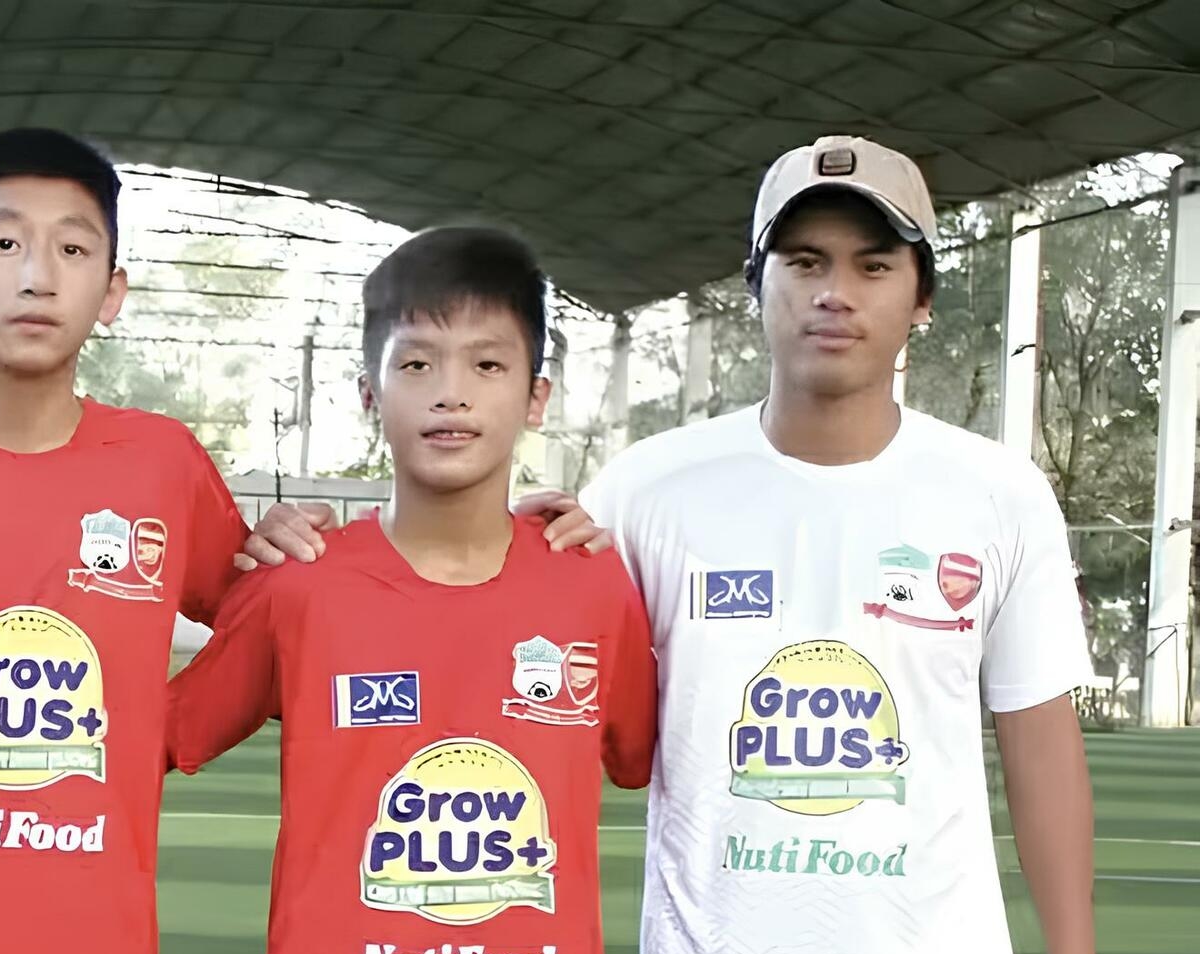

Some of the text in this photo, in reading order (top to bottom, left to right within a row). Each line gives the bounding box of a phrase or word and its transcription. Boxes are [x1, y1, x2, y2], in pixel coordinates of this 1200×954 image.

[750, 677, 882, 719] Grow
[736, 725, 904, 769] PLUS+
[387, 782, 526, 823] Grow
[369, 830, 548, 873] PLUS+
